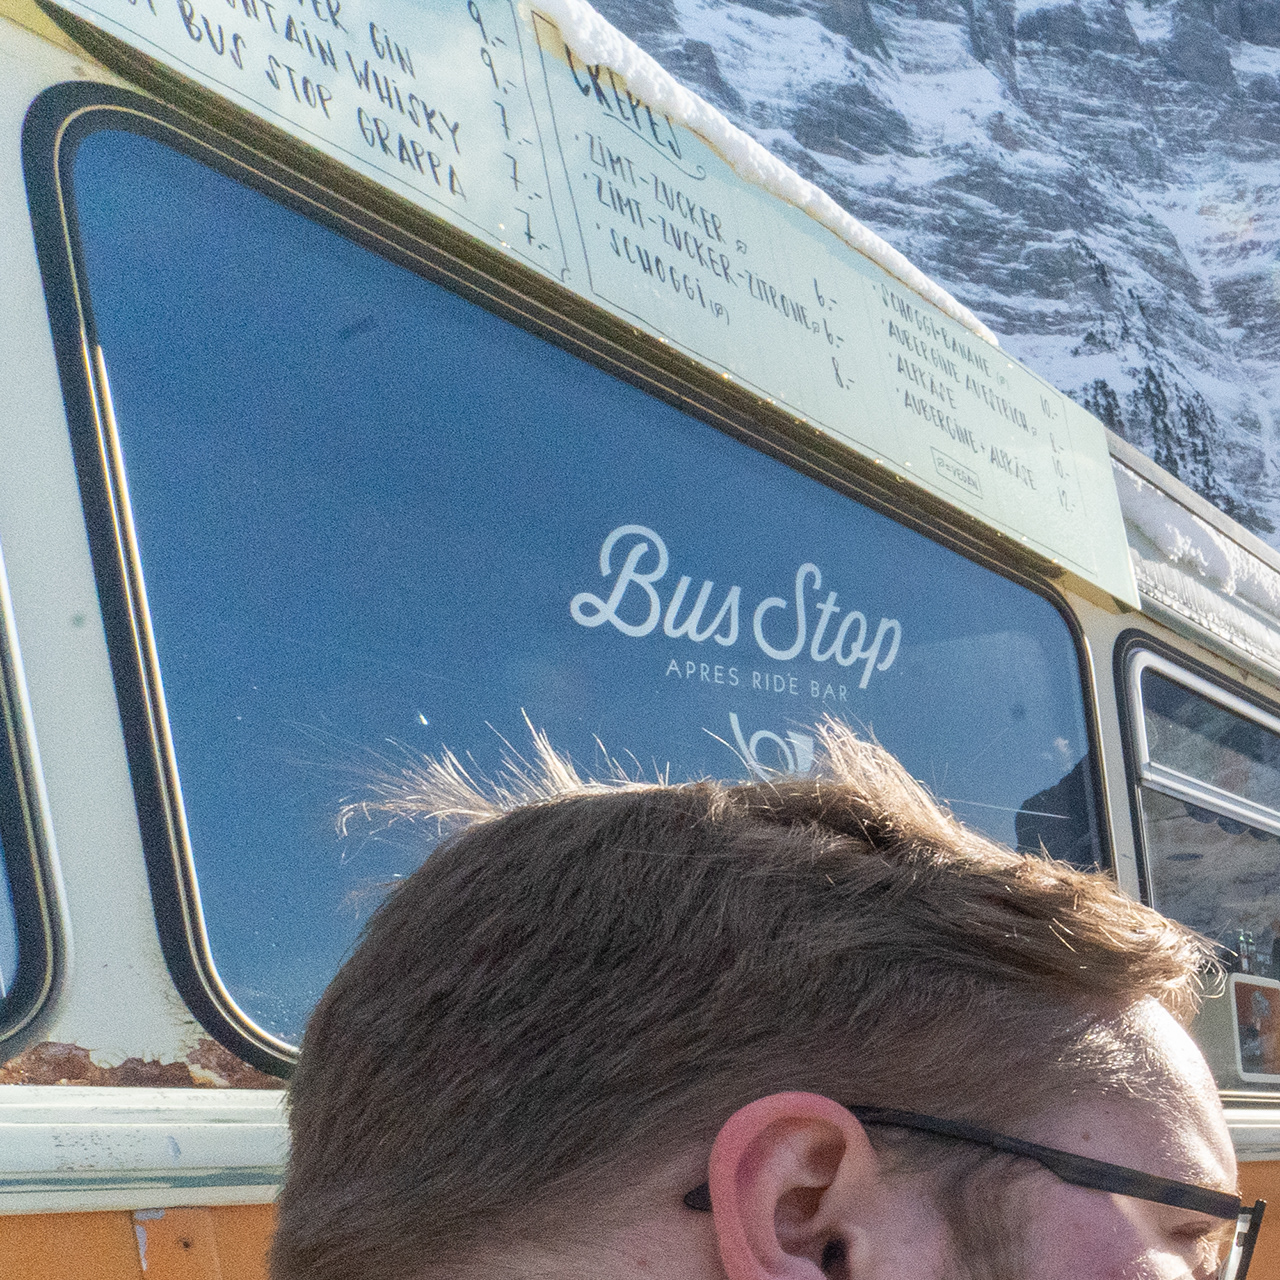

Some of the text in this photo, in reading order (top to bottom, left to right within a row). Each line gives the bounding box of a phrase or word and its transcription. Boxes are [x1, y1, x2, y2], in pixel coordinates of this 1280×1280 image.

[175, 0, 247, 71] BUS
[265, 55, 334, 120] STOP
[357, 106, 468, 202] GRAPPA
[570, 524, 902, 689] Bus Stop
[665, 659, 848, 702] APRES RIDE BAR
